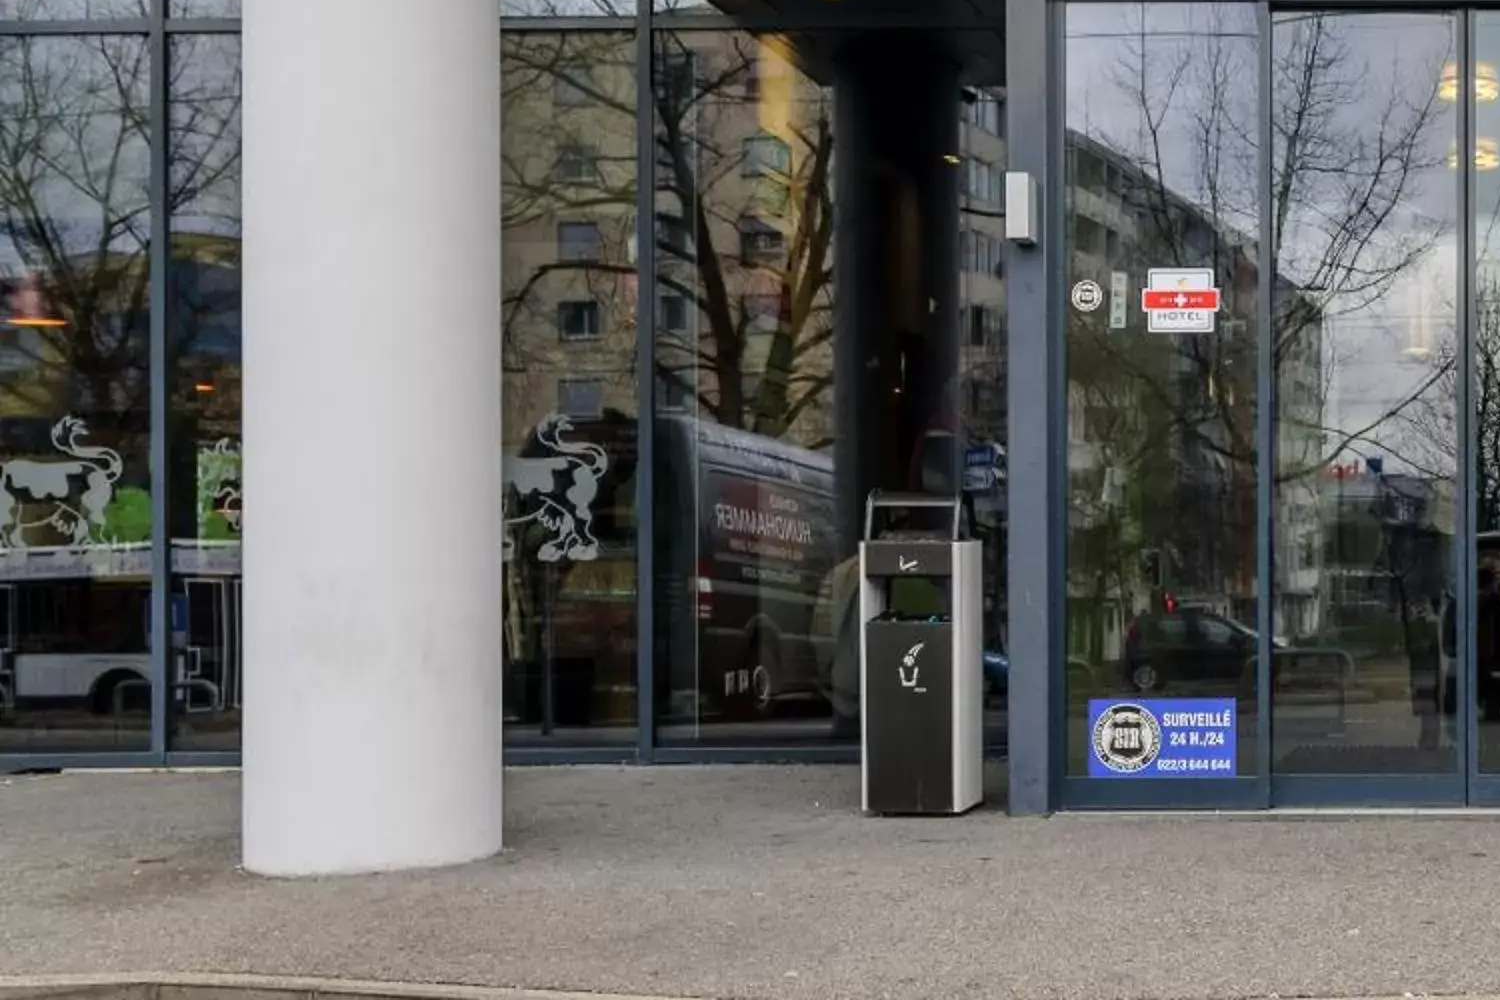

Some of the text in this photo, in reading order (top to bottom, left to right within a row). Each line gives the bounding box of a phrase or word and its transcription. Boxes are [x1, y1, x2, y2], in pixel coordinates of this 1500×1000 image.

[1157, 311, 1202, 321] HOTEL
[1163, 709, 1231, 727] SURVEILLÉ
[1169, 731, 1187, 745] 24
